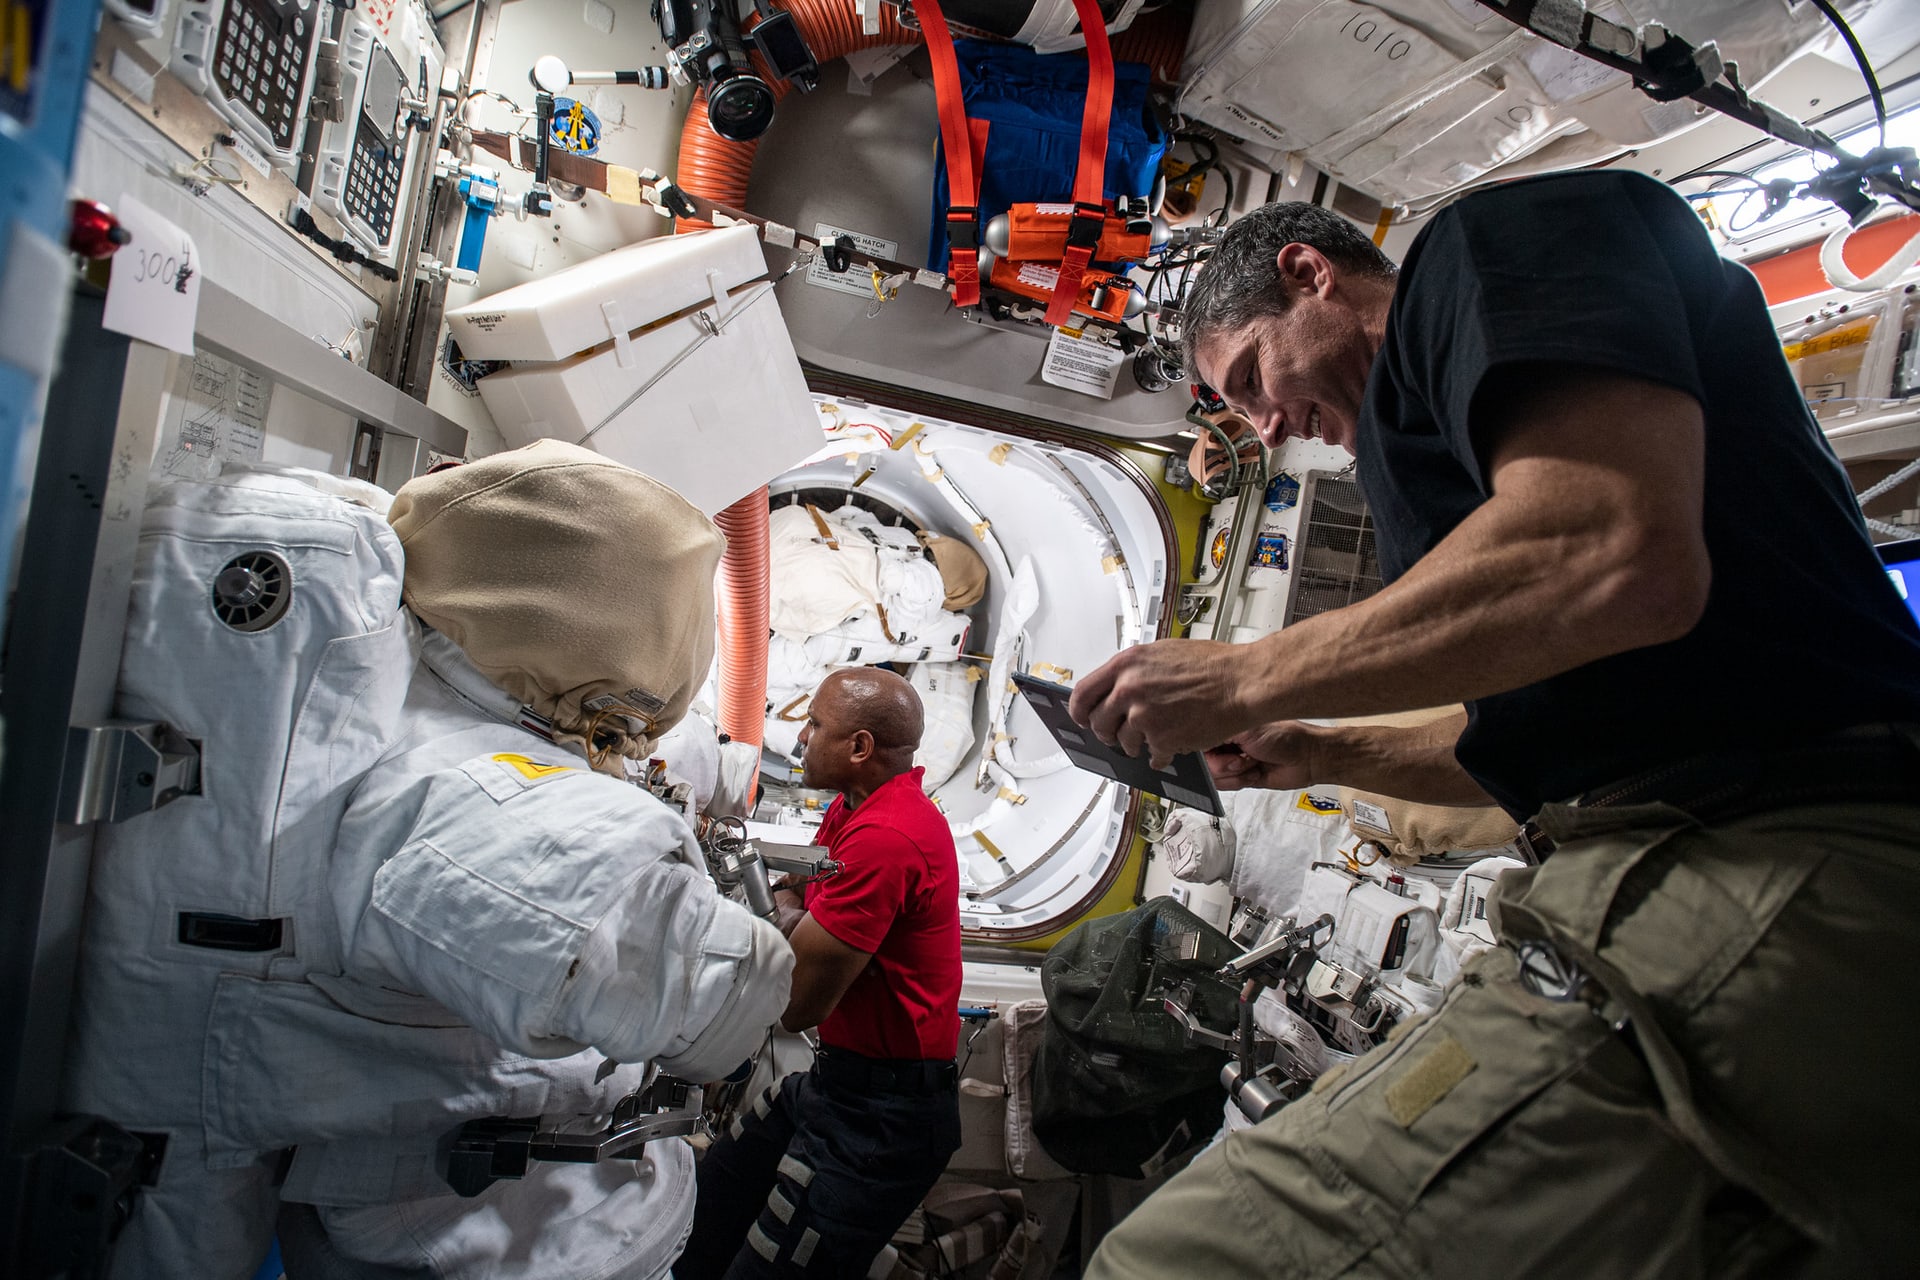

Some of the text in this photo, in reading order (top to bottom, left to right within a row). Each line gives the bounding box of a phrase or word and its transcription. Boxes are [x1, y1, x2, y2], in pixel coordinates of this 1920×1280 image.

[1340, 11, 1411, 60] 1010
[1224, 104, 1248, 121] ONLY
[862, 238, 886, 249] HATCH
